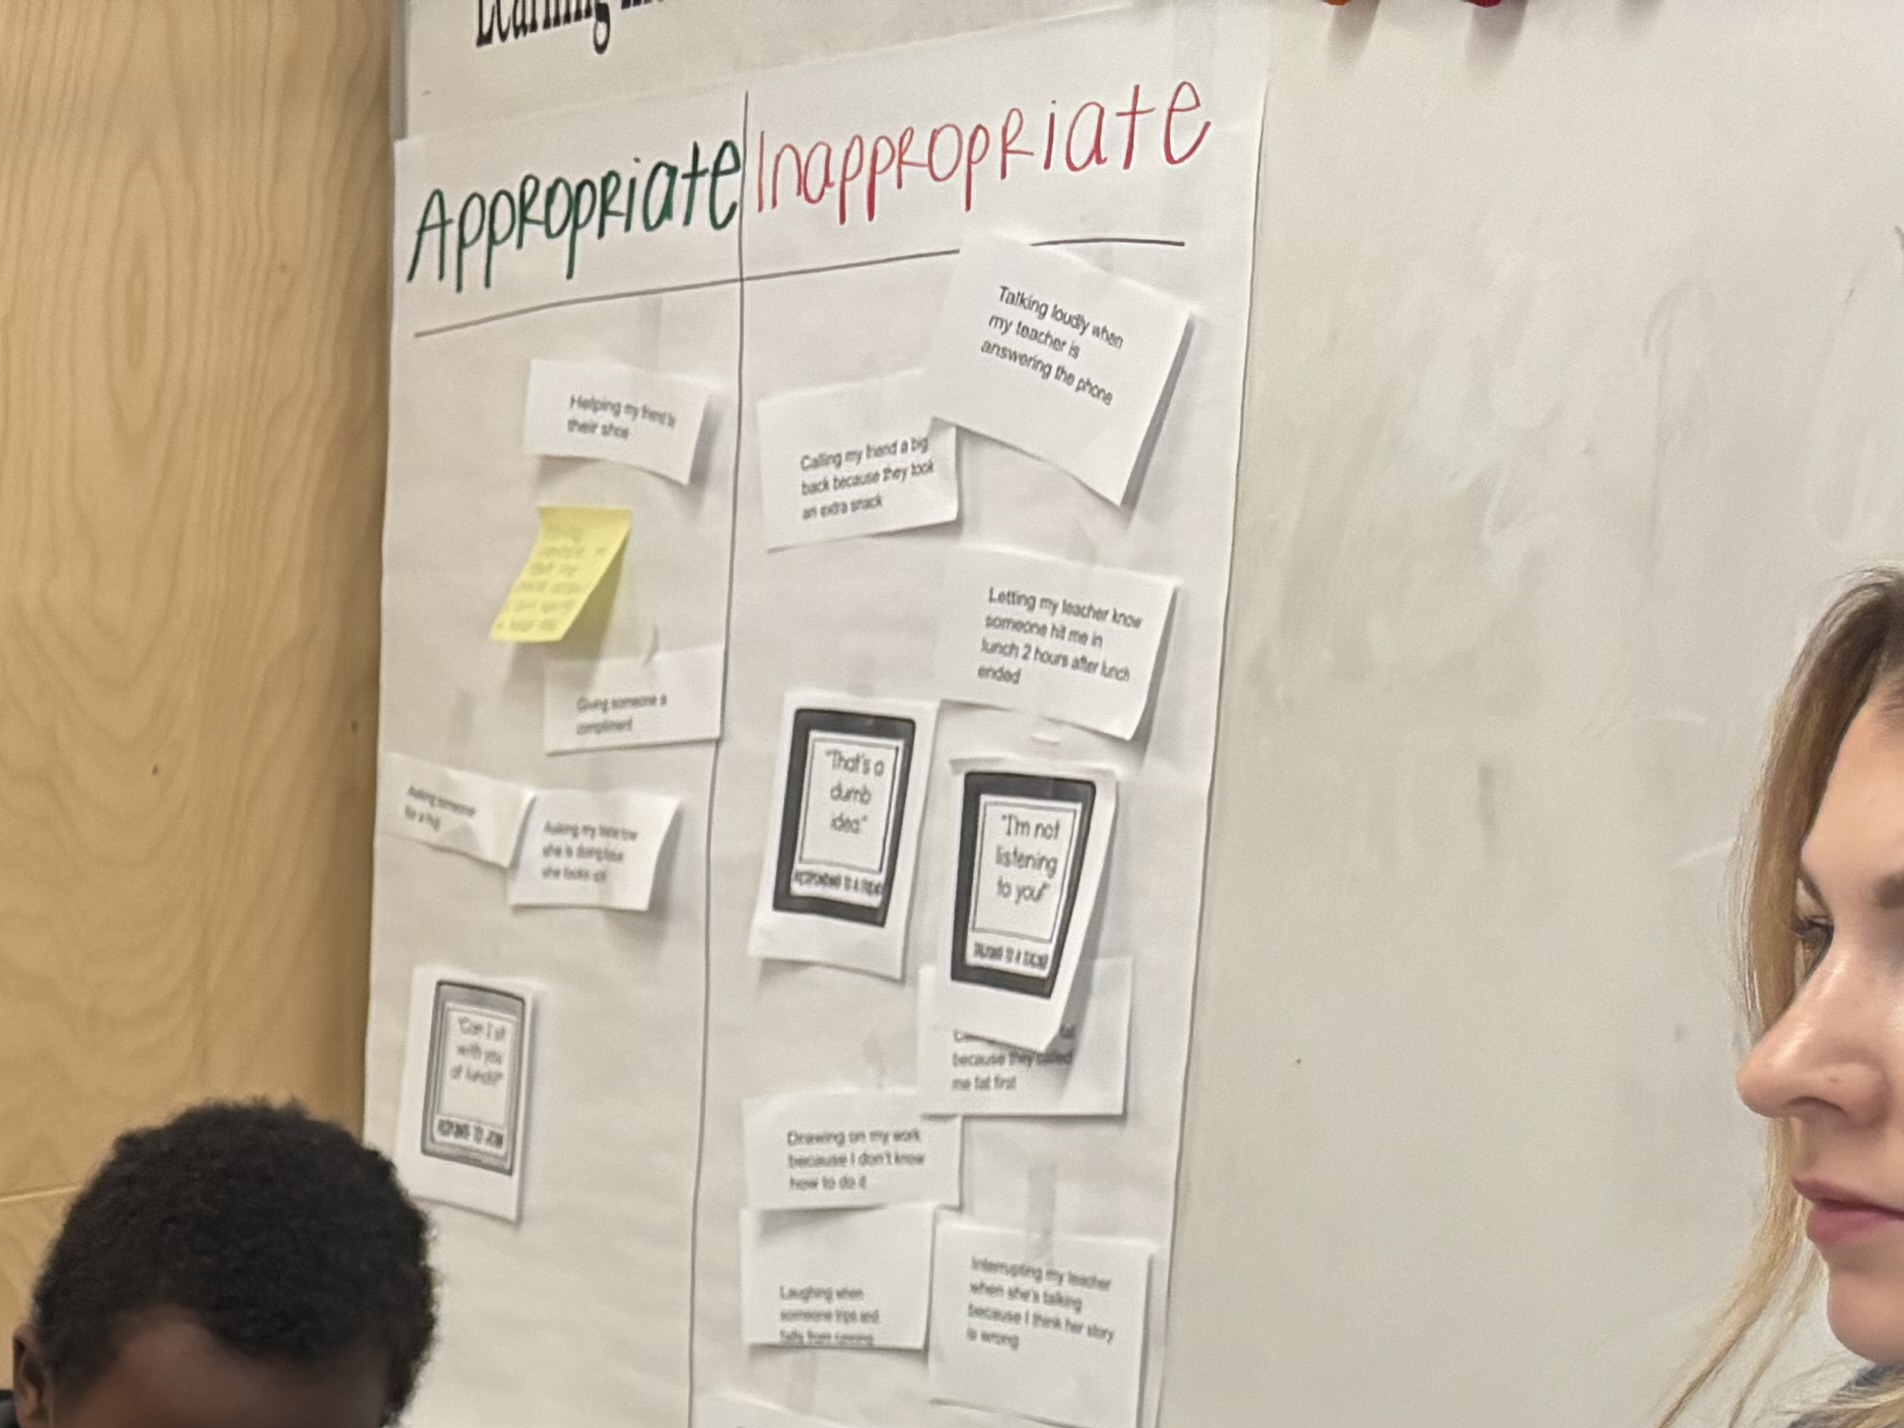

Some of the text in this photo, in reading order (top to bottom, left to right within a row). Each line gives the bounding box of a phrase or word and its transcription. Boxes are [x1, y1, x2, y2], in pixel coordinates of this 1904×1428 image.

[999, 285, 1124, 350] Talking loudly when
[988, 315, 1080, 359] my teacher is
[980, 340, 1114, 406] answering the phone
[800, 437, 929, 470] Calling my friend a big
[802, 459, 934, 496] back because they took
[989, 586, 1143, 629] Letting my teacher know
[985, 614, 1103, 648] someone hit me in
[981, 638, 1019, 658] lunch
[1022, 643, 1032, 661] 2
[1034, 646, 1068, 668] hours
[1071, 654, 1100, 674] after
[978, 665, 1022, 685] ended
[874, 760, 884, 777] a
[830, 782, 872, 804] dumb
[1033, 819, 1060, 839] not
[995, 845, 1059, 879] listening
[997, 876, 1011, 898] to
[952, 1053, 1005, 1068] because
[787, 1127, 921, 1147] Drawing on my work
[788, 1153, 848, 1169] because
[859, 1152, 891, 1166] don't
[894, 1150, 925, 1166] know
[790, 1175, 818, 1191] how
[822, 1176, 836, 1190] to
[839, 1175, 856, 1190] do
[970, 1256, 1112, 1291] Interrupting my teacher
[969, 1281, 1004, 1298] when
[1042, 1290, 1083, 1313] talking
[967, 1303, 1021, 1324] because
[1032, 1313, 1062, 1330] think
[980, 1330, 1020, 1351] wrong
